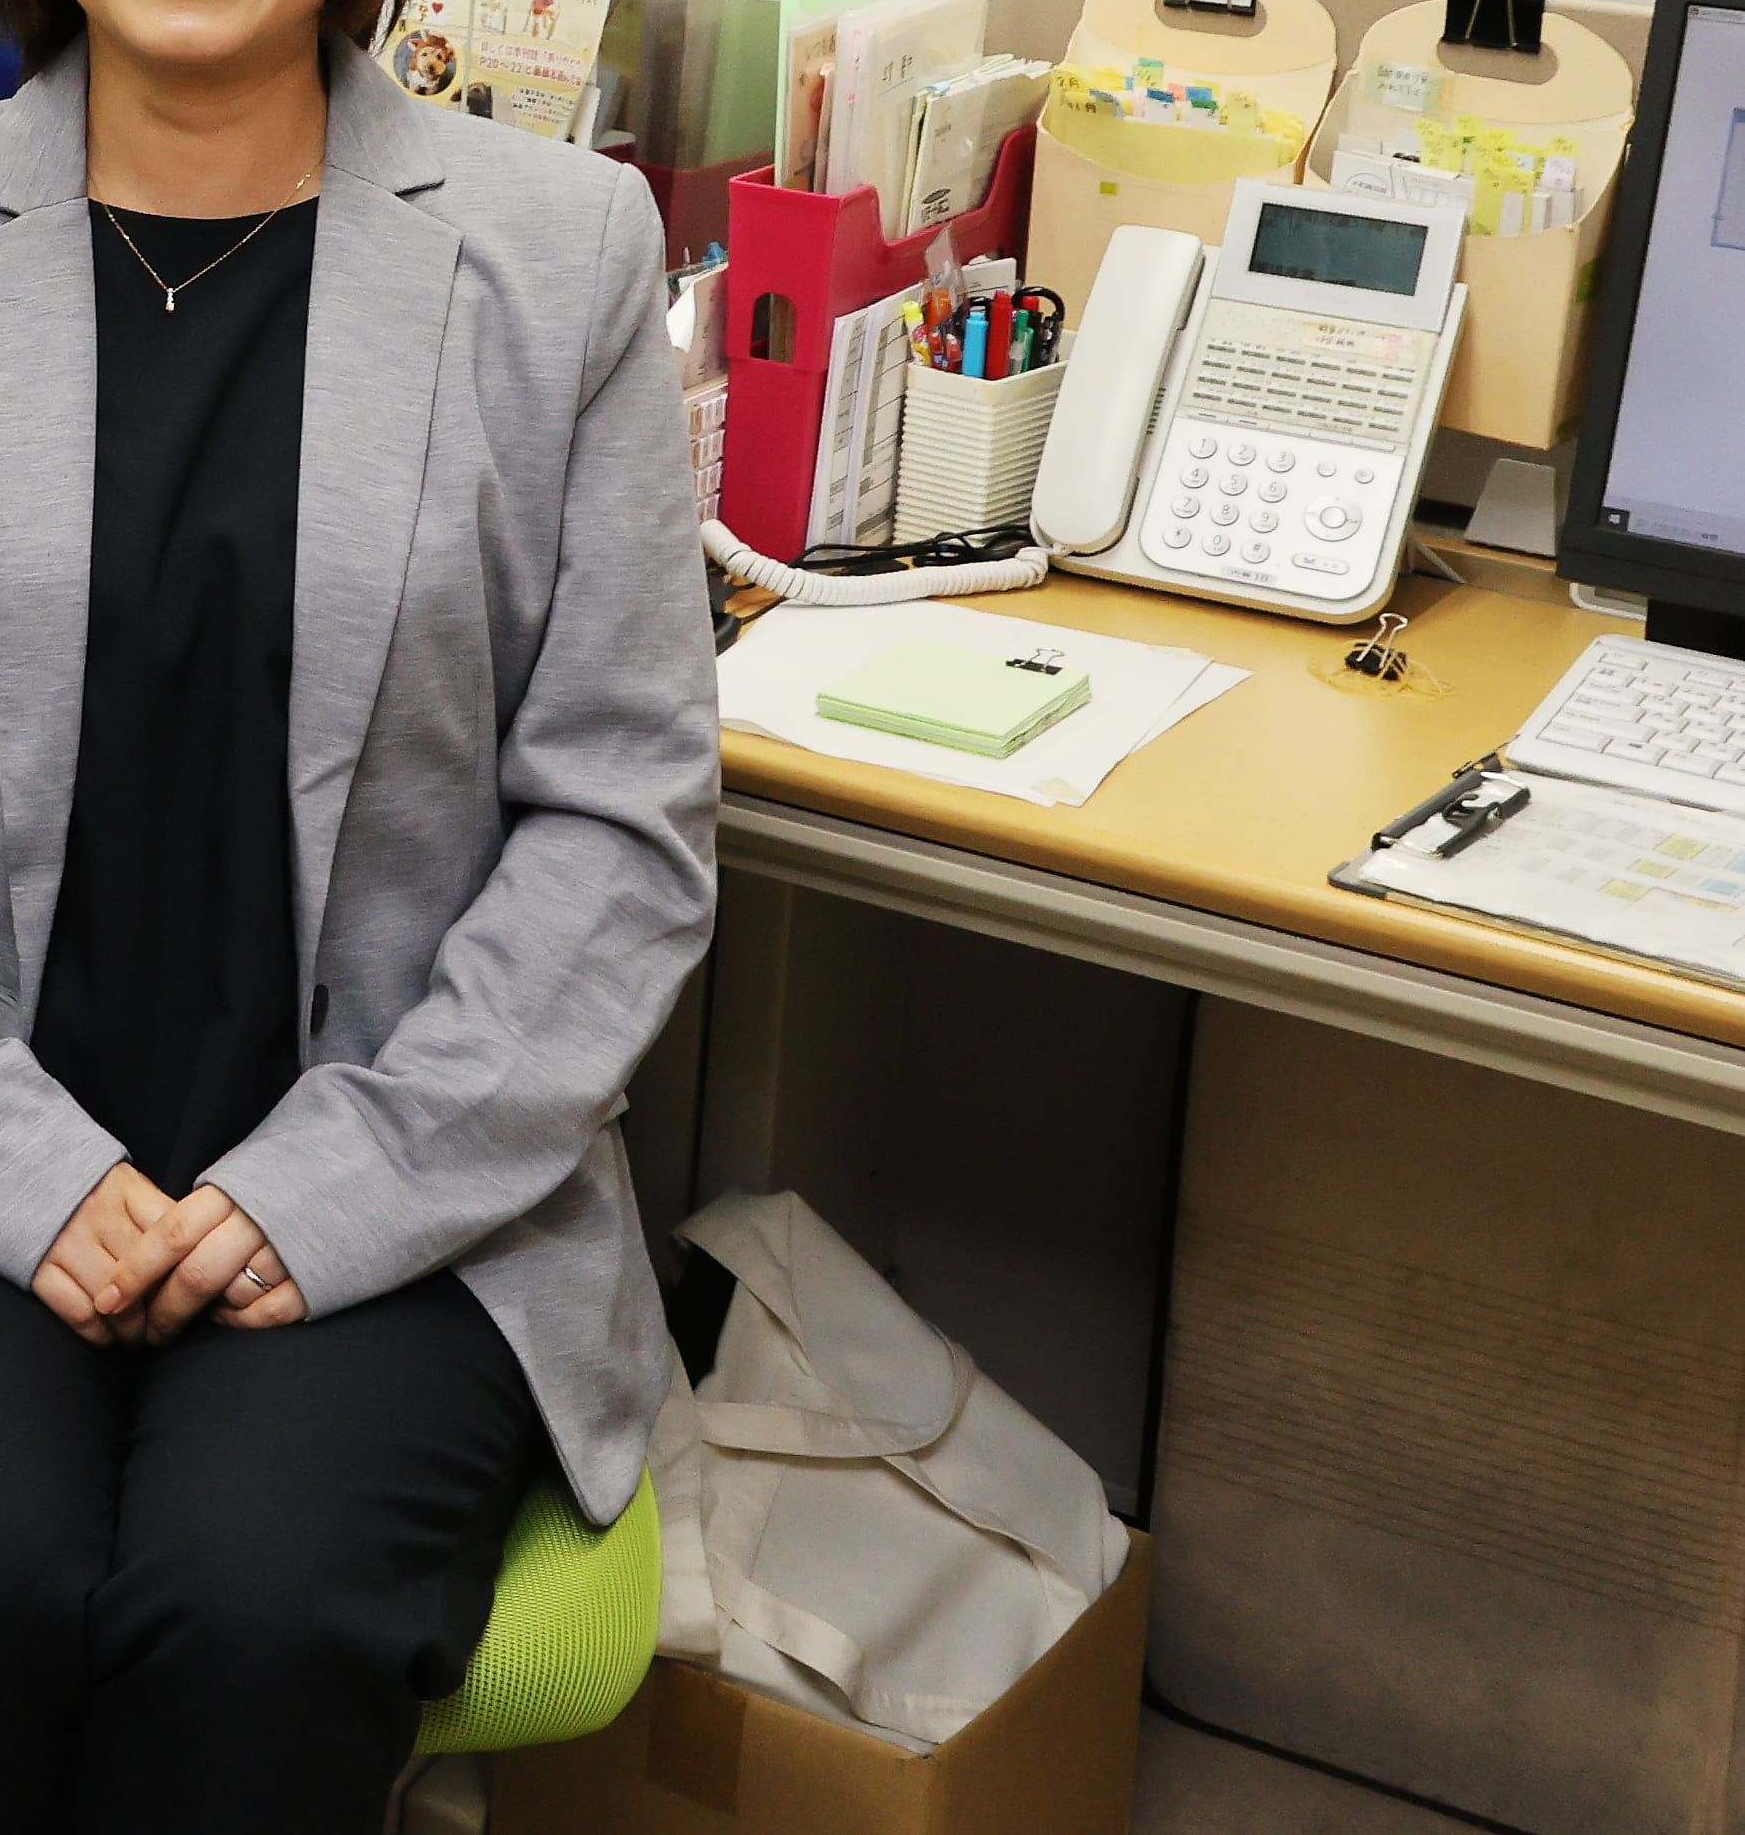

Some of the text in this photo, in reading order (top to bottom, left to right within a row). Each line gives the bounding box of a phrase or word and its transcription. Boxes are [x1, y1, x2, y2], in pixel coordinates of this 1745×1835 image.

[1238, 445, 1247, 455] 2
[1191, 468, 1199, 478] 4
[1269, 481, 1277, 492] 6
[1221, 504, 1229, 515] 8
